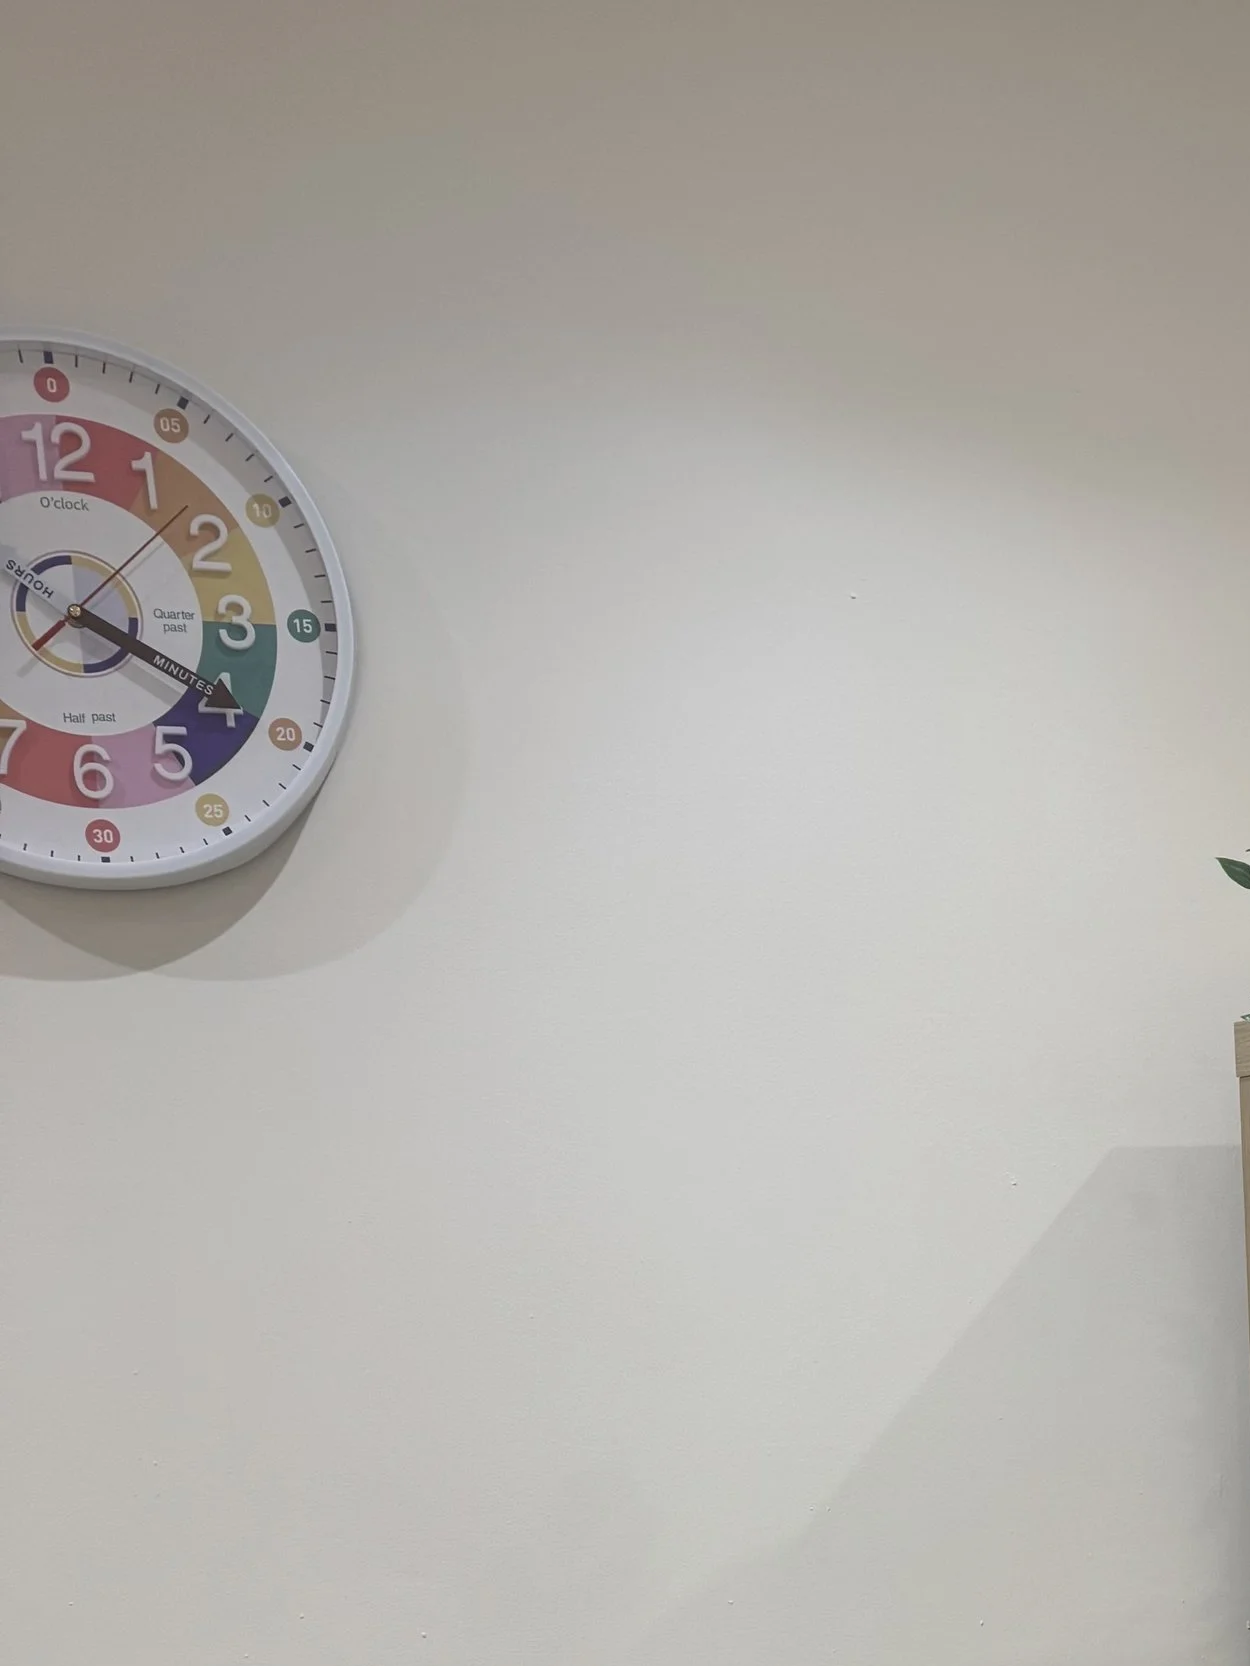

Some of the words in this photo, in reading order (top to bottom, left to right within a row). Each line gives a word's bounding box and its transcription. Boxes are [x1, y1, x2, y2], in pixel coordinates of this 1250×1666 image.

[47, 377, 57, 393] 0
[160, 417, 181, 433] 05
[20, 421, 96, 483] 12
[130, 451, 159, 511] 1
[40, 496, 90, 513] O'clock
[252, 502, 272, 519] 10
[189, 513, 232, 573] 2
[5, 559, 54, 599] HOURS
[153, 608, 196, 621] Quarter
[217, 594, 256, 651] 3
[163, 622, 188, 634] past
[293, 618, 313, 634] 15
[153, 655, 214, 696] MINUTES
[63, 712, 86, 724] Half
[91, 712, 117, 724] past
[276, 726, 296, 742] 20
[153, 725, 193, 781] 5
[73, 743, 115, 799] 6
[203, 804, 224, 819] 25
[92, 828, 114, 844] 30
